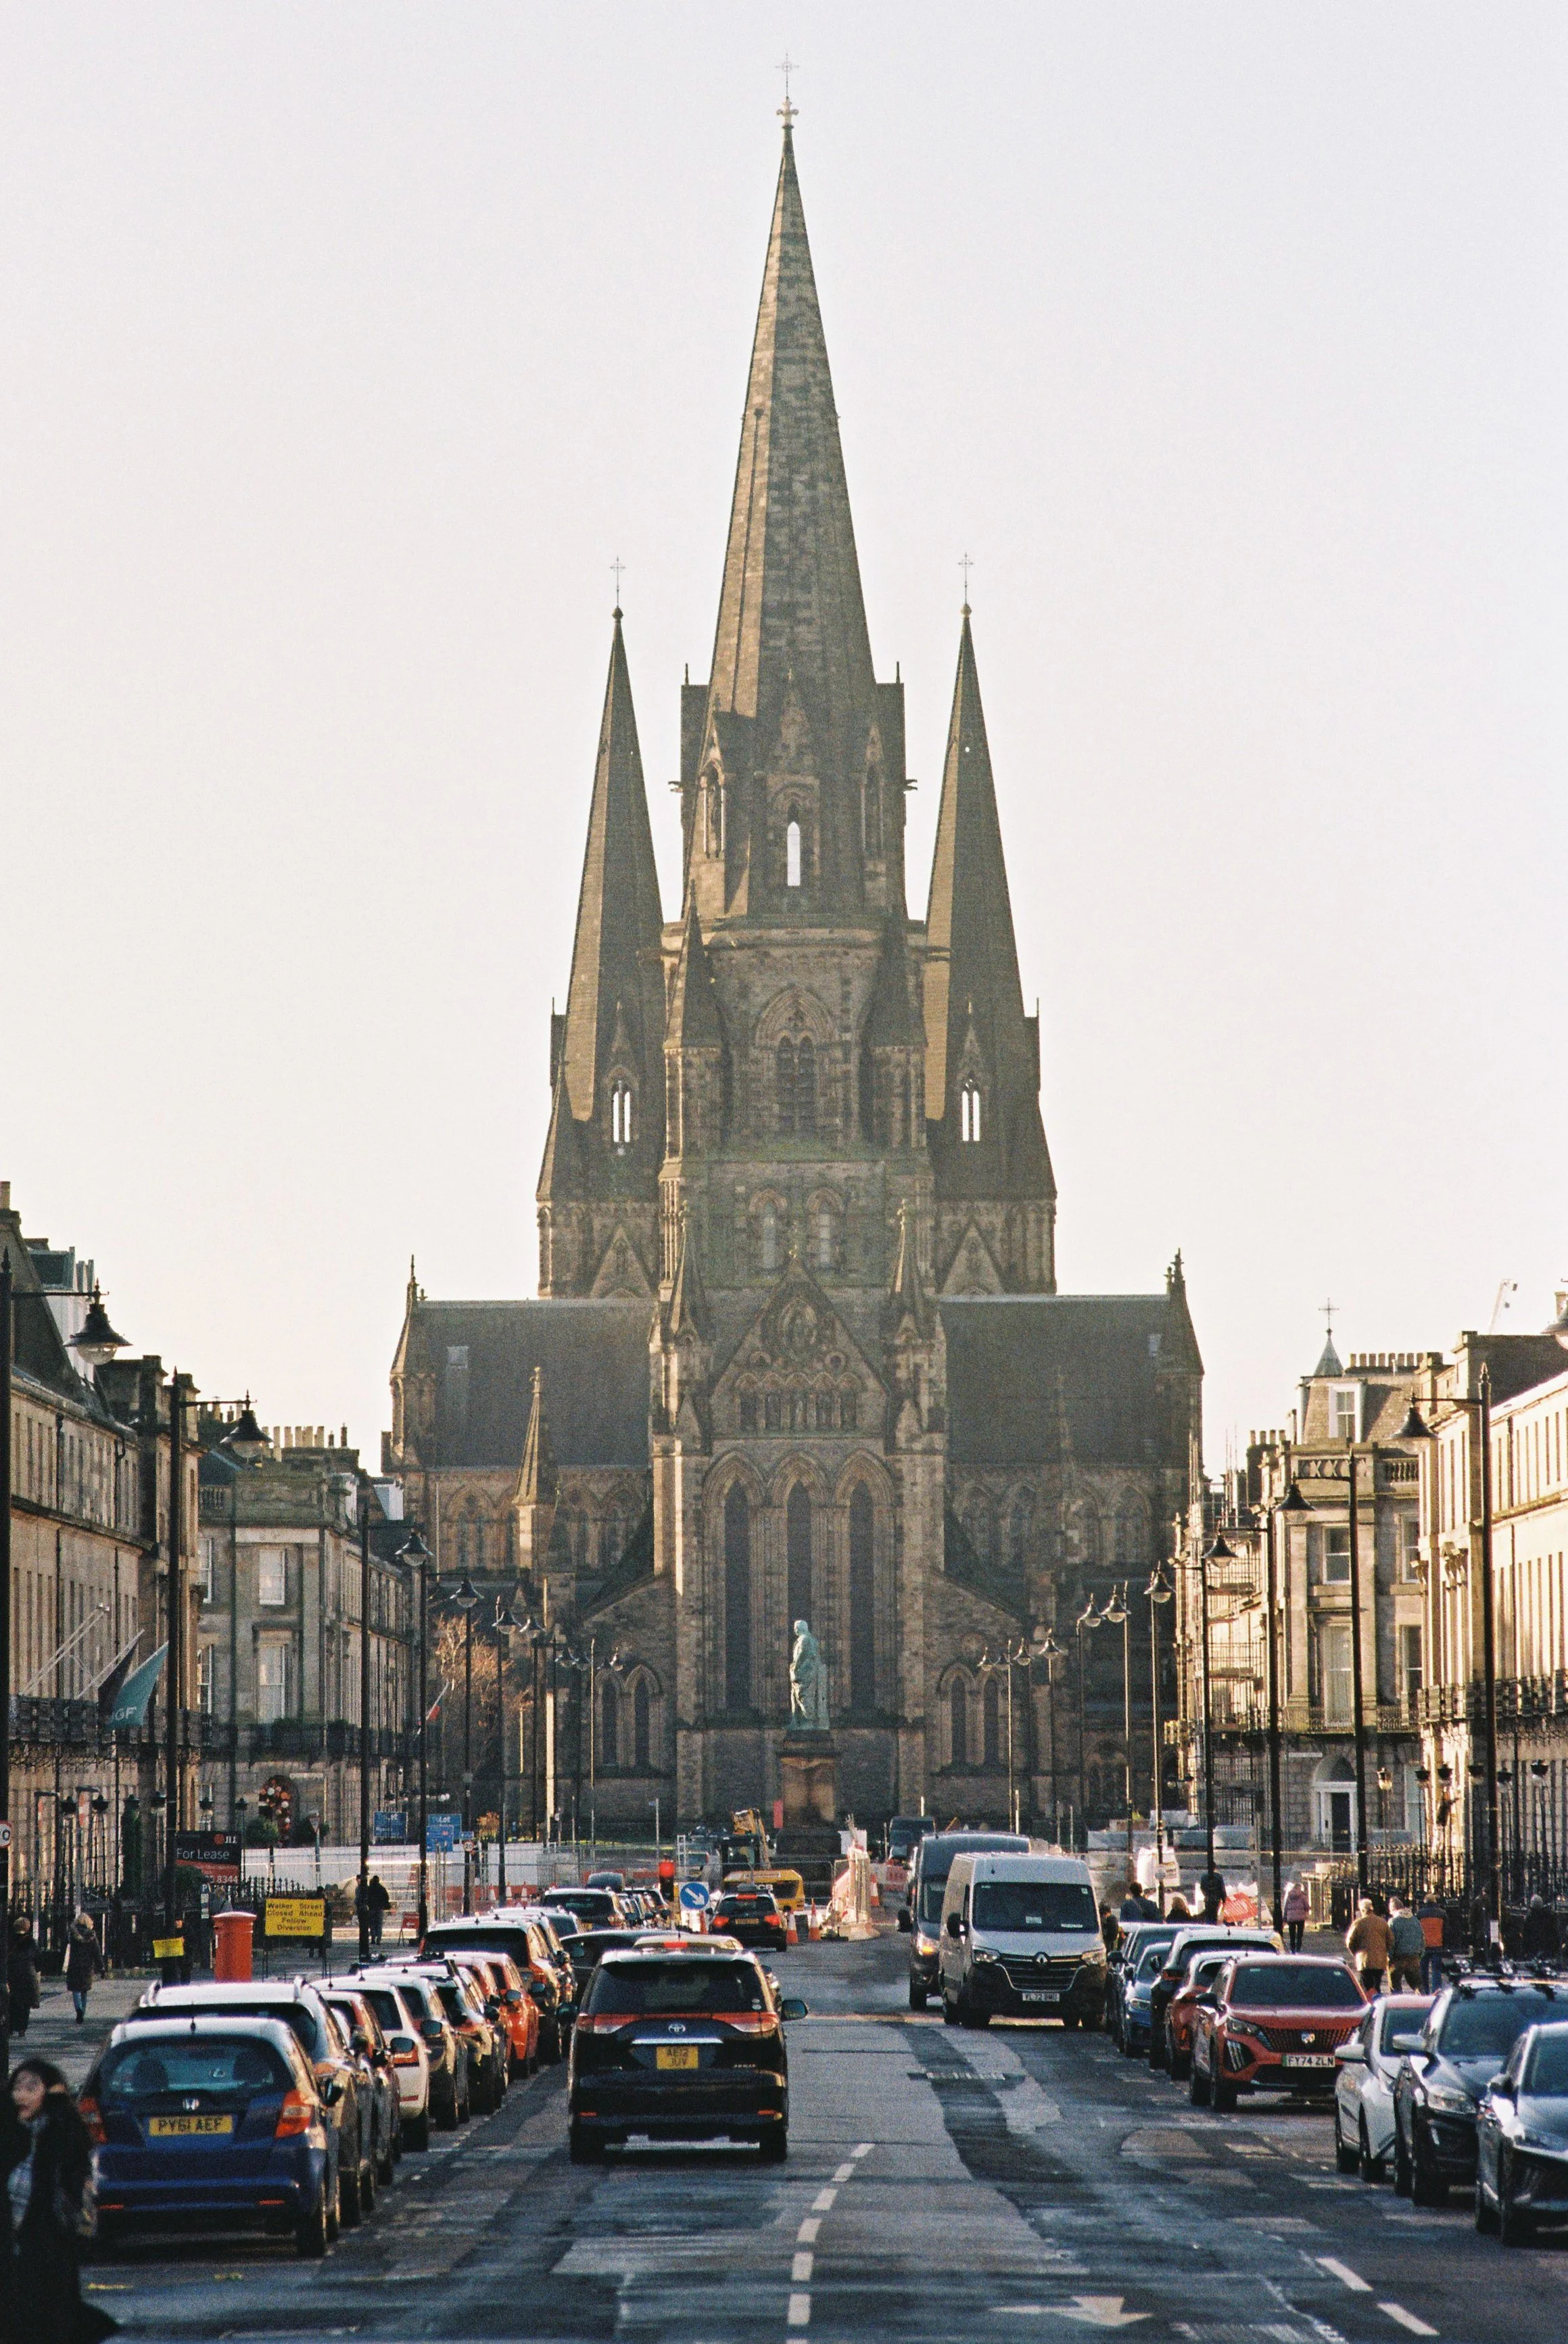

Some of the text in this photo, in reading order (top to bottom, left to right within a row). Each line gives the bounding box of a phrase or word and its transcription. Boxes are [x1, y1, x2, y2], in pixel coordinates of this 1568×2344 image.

[176, 1848, 230, 1860] For Lease
[217, 1875, 238, 1884] 8344
[1288, 2055, 1334, 2066] FY74 ZLN
[195, 2117, 223, 2132] AEF
